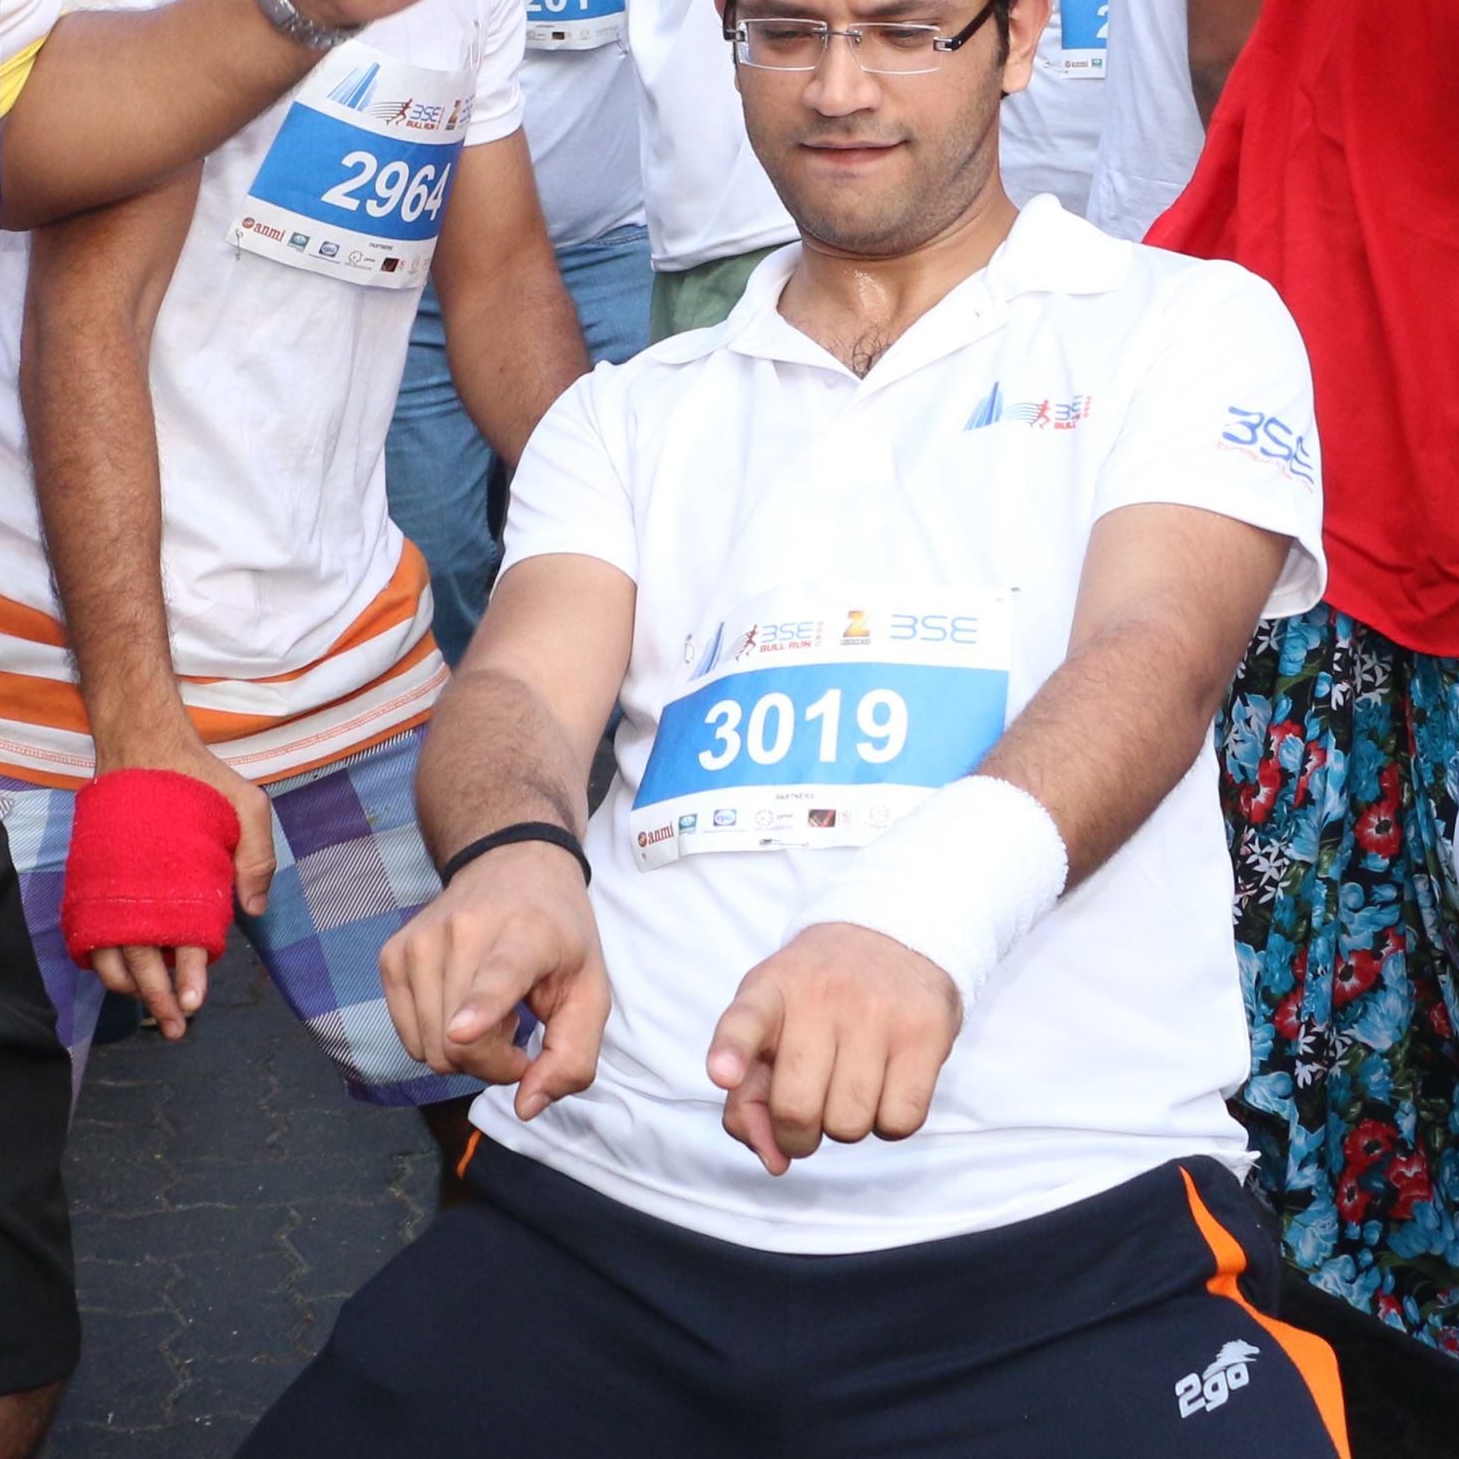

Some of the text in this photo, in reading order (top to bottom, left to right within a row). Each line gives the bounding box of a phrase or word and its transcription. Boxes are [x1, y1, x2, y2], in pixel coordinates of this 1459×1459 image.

[321, 150, 452, 222] 2964
[760, 643, 785, 653] BULL
[788, 640, 811, 651] RUN
[698, 689, 909, 772] 3019
[647, 822, 675, 845] anmi
